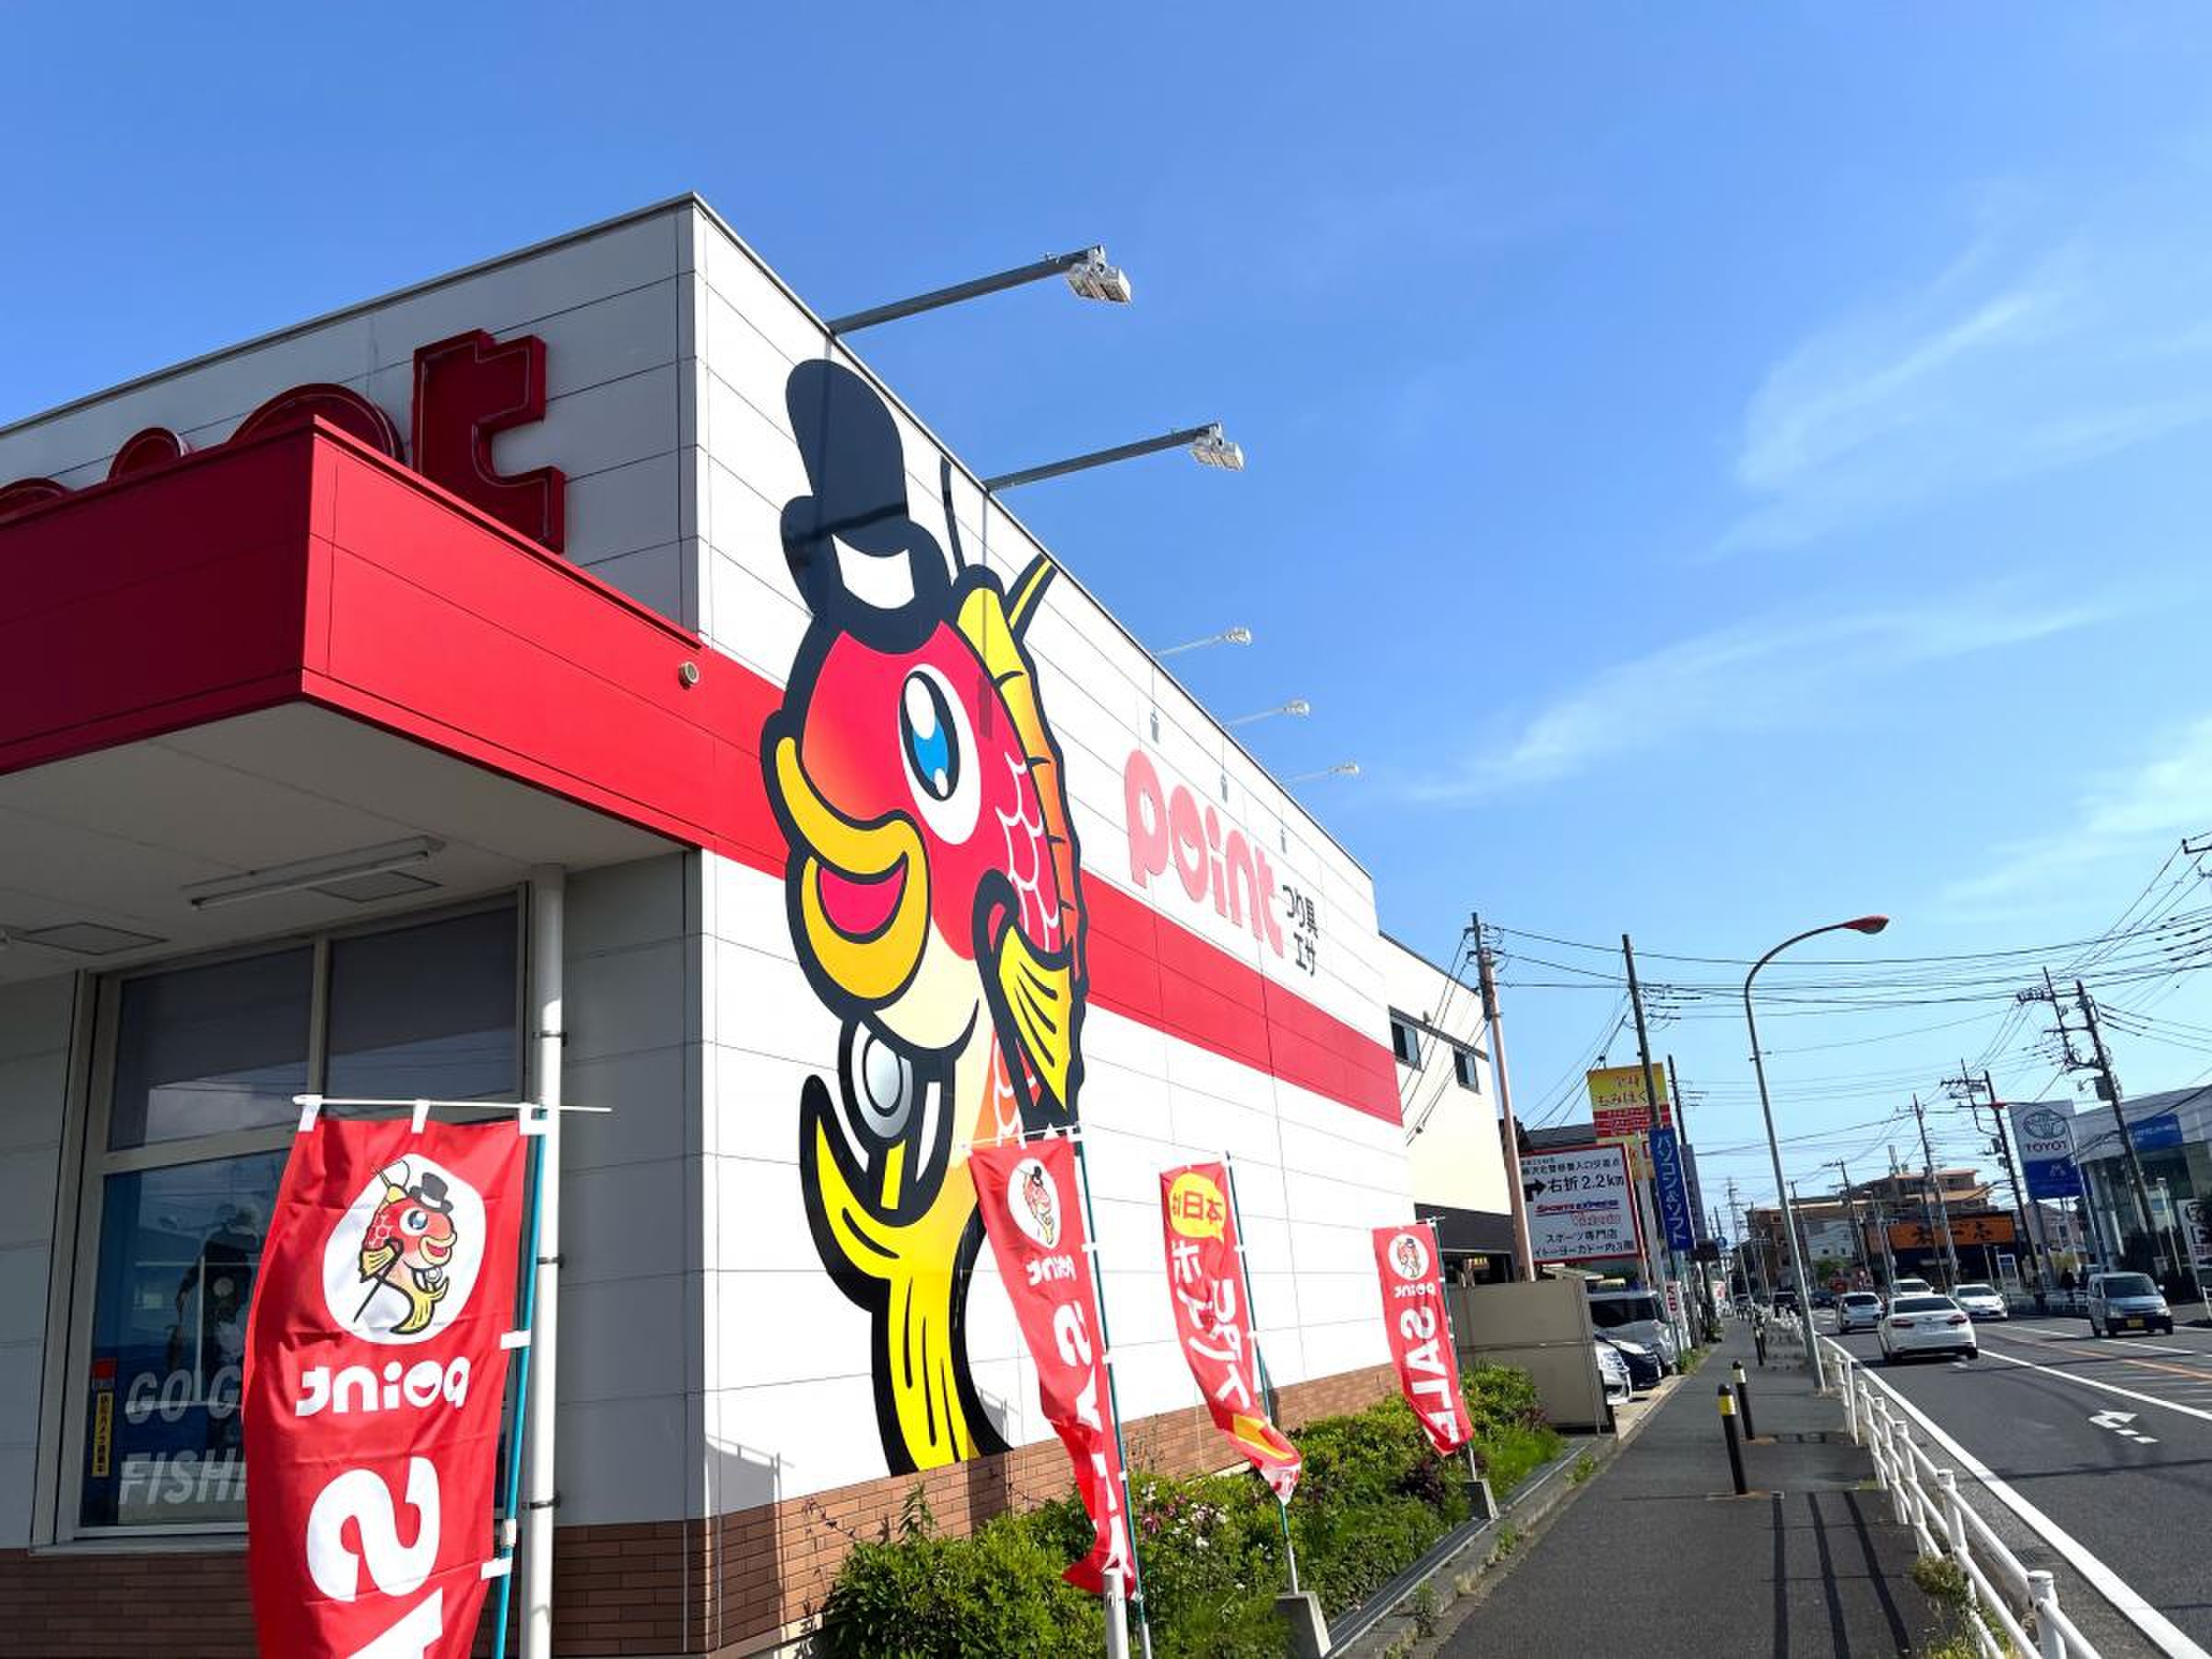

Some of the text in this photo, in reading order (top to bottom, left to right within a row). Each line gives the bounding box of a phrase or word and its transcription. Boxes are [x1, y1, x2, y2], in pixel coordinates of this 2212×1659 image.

[1282, 885, 1318, 939] つり具
[1293, 932, 1316, 978] エサ
[124, 1369, 193, 1425] GO
